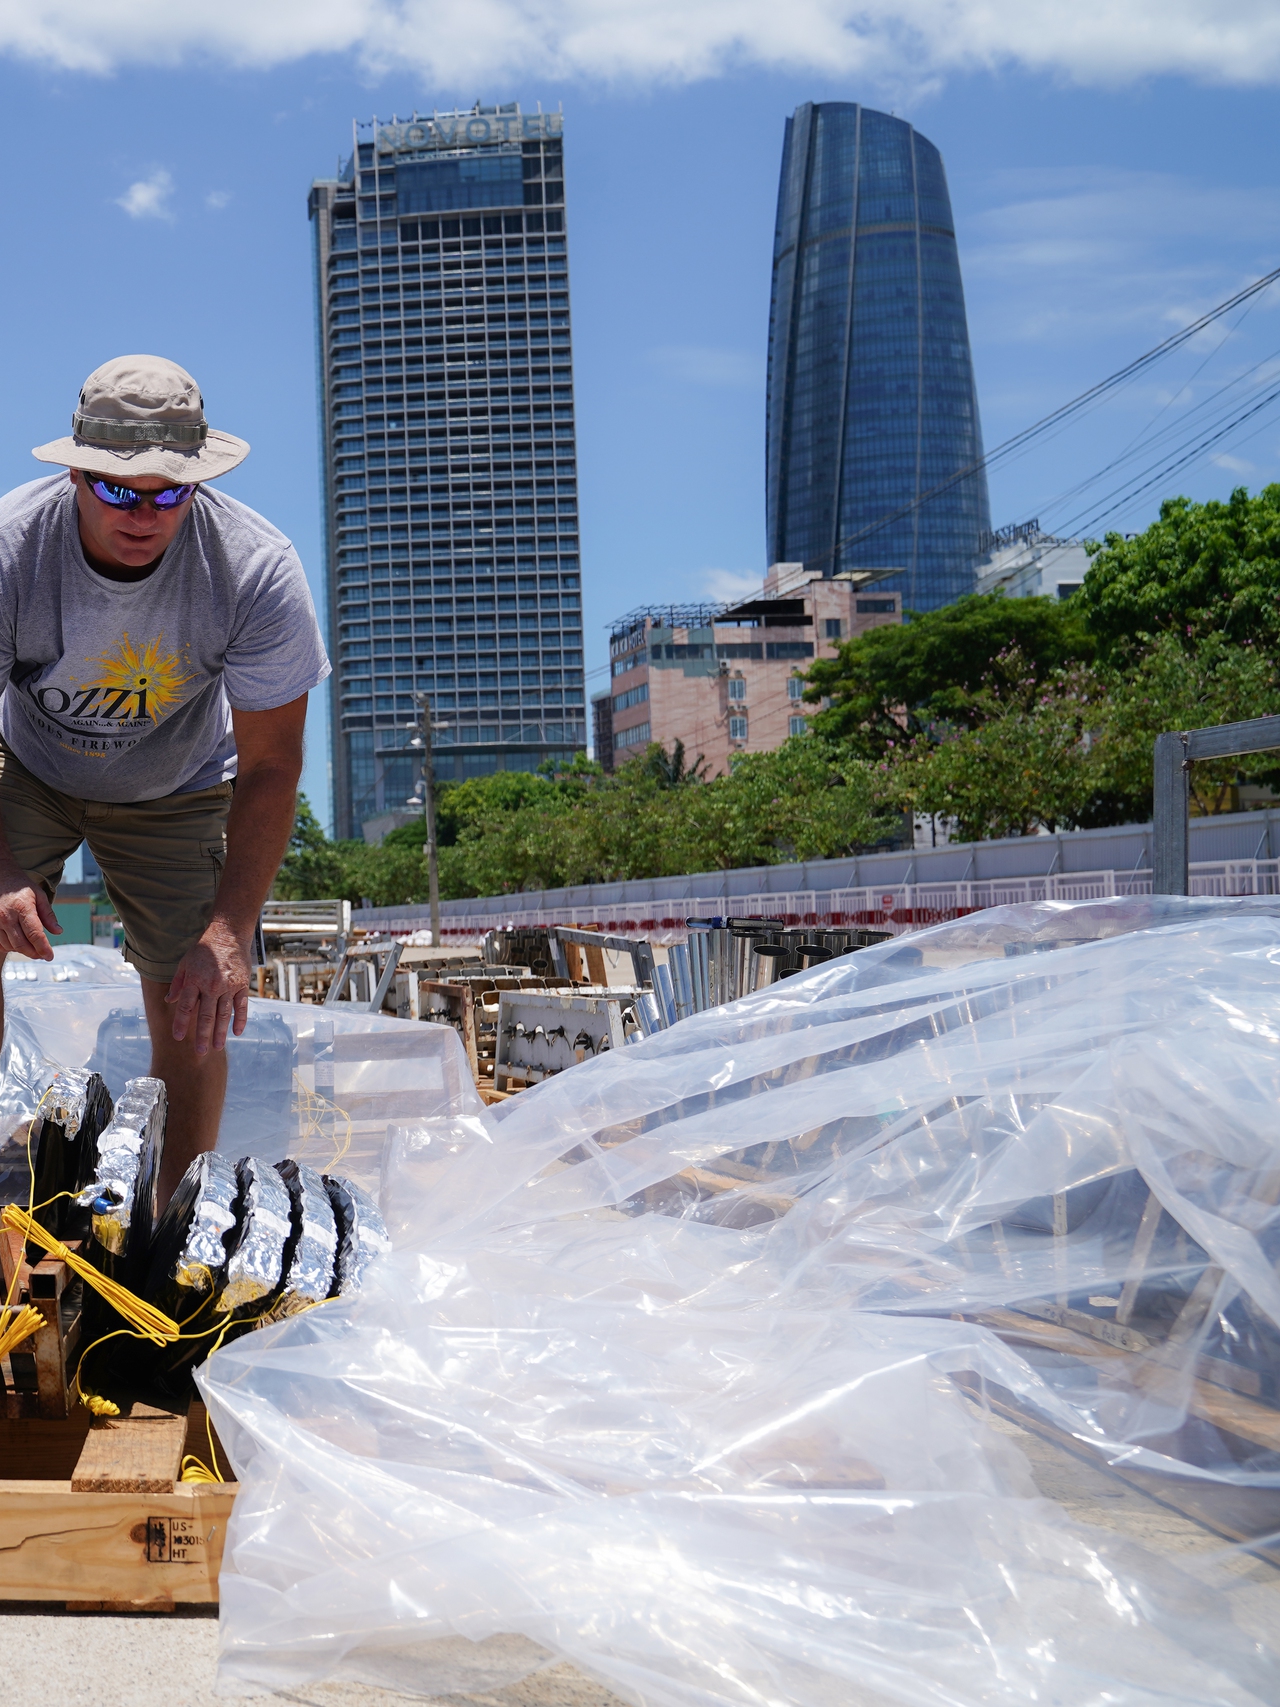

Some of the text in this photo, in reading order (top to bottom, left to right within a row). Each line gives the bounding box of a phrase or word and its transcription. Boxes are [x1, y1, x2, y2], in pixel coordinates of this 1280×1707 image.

[377, 114, 564, 152] NOVOTEL
[23, 704, 145, 751] MOUS FIREWO
[172, 1548, 188, 1559] HT
